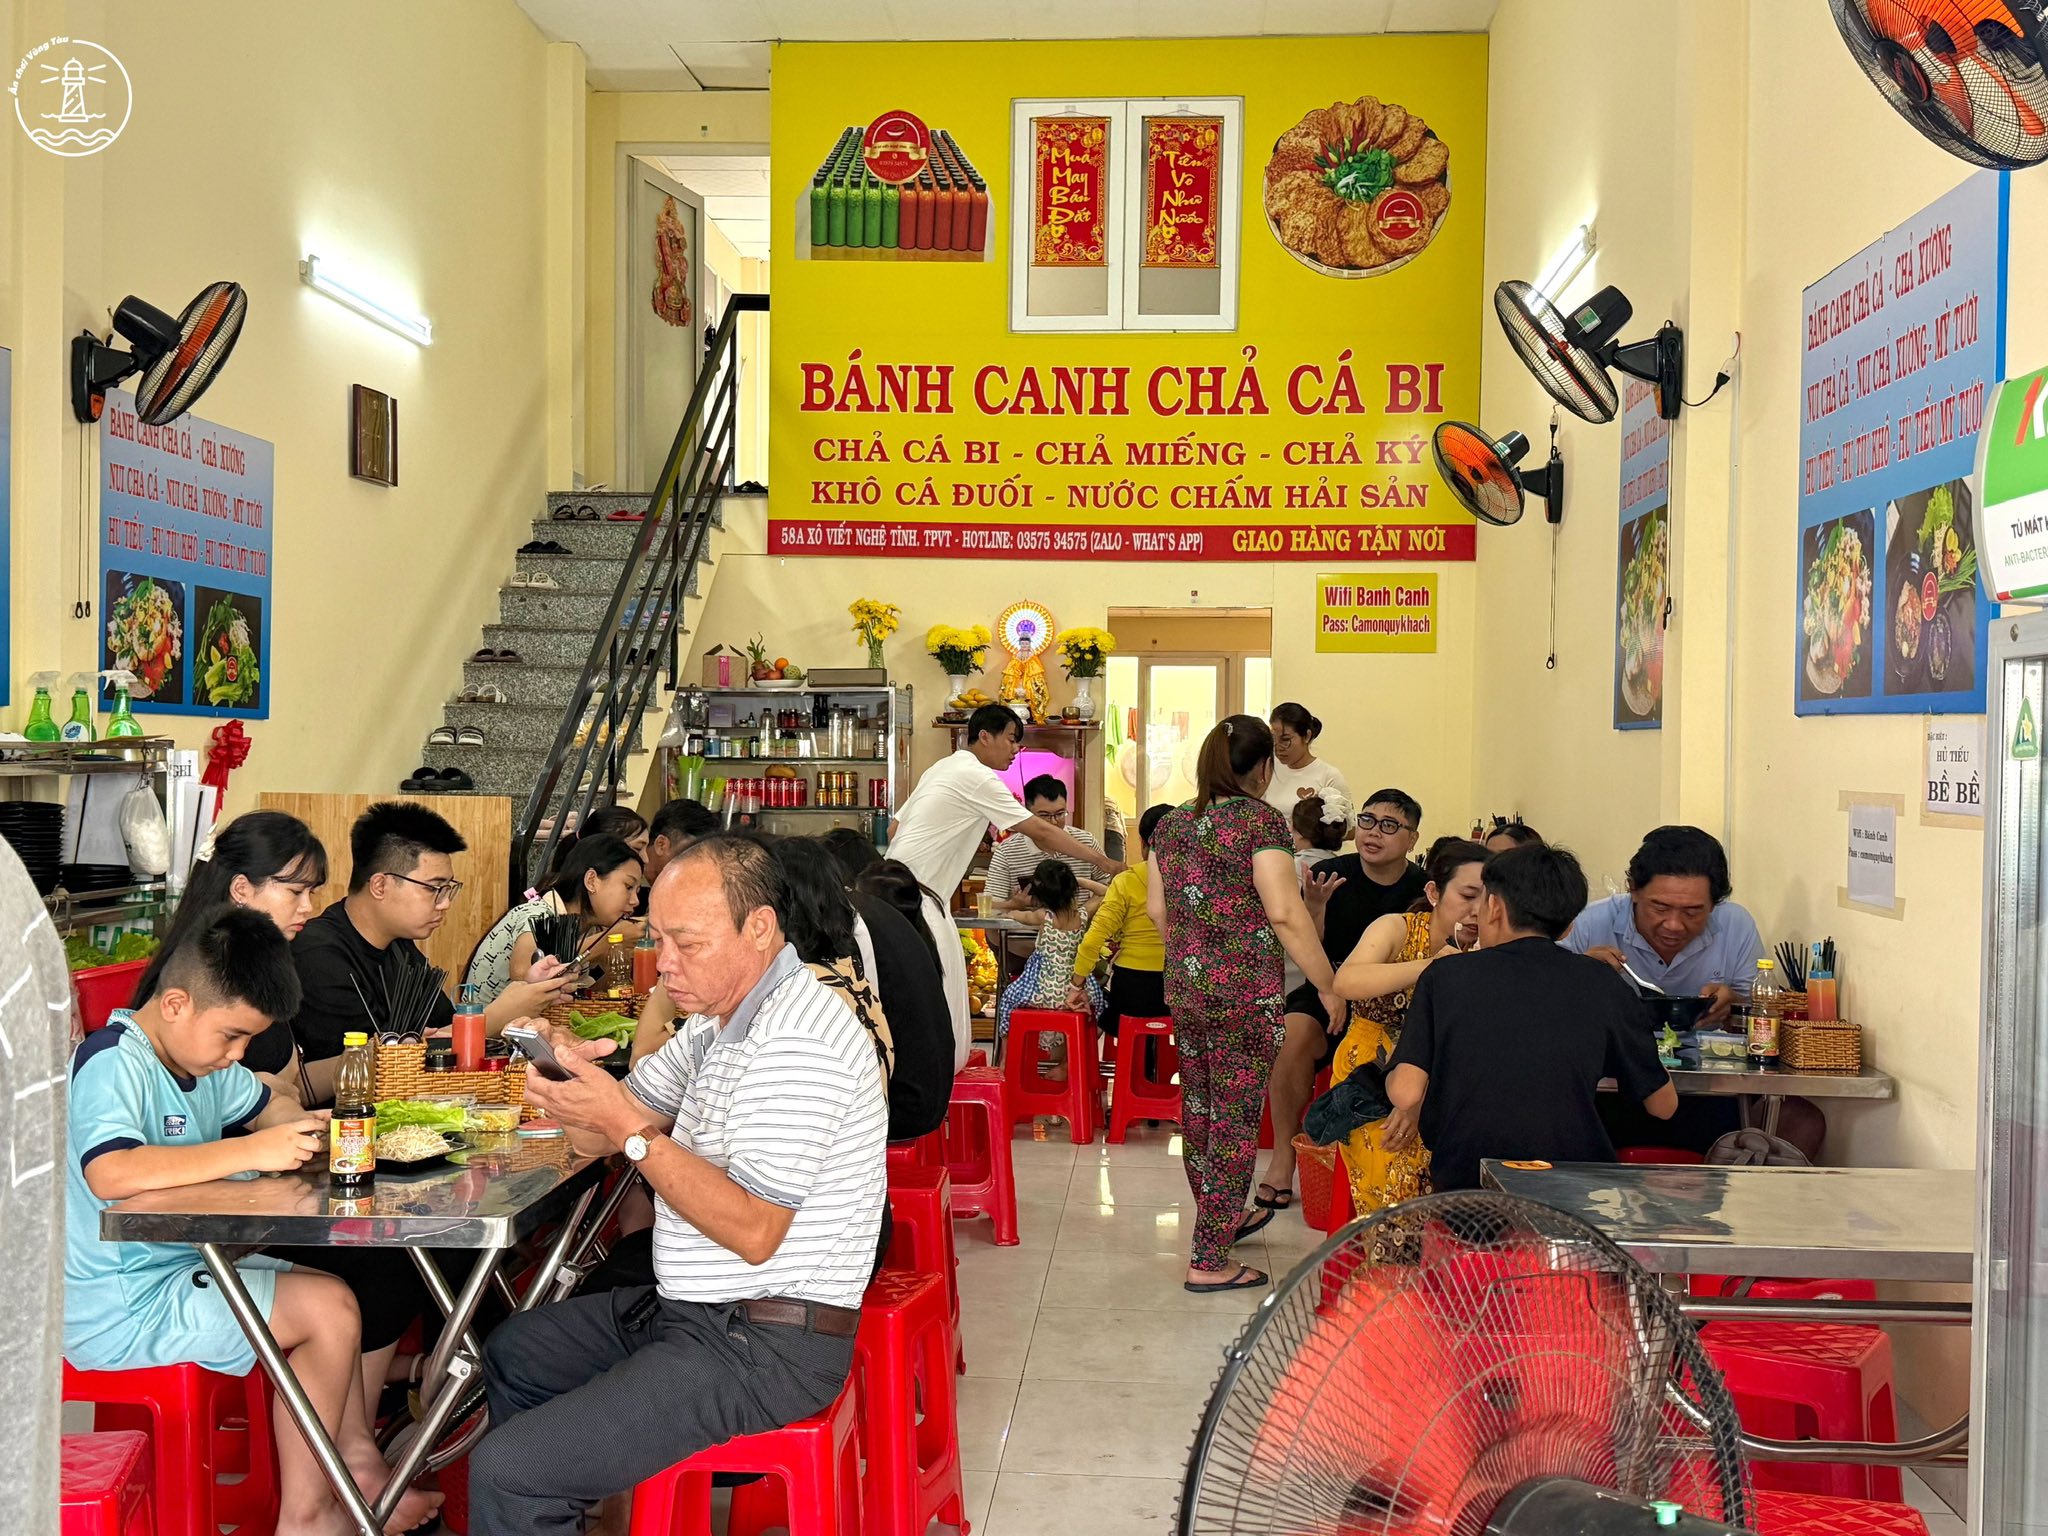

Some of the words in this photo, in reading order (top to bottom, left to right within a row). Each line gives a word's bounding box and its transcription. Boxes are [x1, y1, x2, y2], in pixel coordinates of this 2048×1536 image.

[1052, 167, 1088, 196] May
[1171, 169, 1196, 187] Vô
[1048, 186, 1091, 205] Bán
[1162, 189, 1203, 208] Như
[1159, 208, 1204, 227] Nước
[1808, 300, 1828, 351] BÁNH
[1830, 289, 1851, 338] CANH
[1853, 261, 1870, 324] CHẢ
[1873, 256, 1884, 311] CÁ
[1895, 232, 1914, 300] CHẢ
[1807, 381, 1819, 424] NUI
[1821, 358, 1836, 417] CHẢ
[1838, 354, 1850, 408] CÁ
[1856, 354, 1871, 400] NUI
[1873, 327, 1891, 390] CHẢ
[1934, 299, 1951, 362] MỲ
[800, 348, 955, 414] BÁNH
[973, 364, 1131, 416] CANH
[1148, 345, 1270, 416] CHẢ
[1287, 348, 1366, 415] CÁ
[1385, 363, 1445, 414] BI
[110, 401, 135, 441] BÁNH
[136, 418, 160, 449] CANH
[202, 432, 217, 467] CHẢ
[1915, 384, 1937, 454] TIẾU
[1939, 383, 1956, 444] MỲ
[813, 430, 890, 463] CHẢ
[902, 433, 951, 464] CÁ
[963, 440, 1000, 464] BI
[1035, 433, 1113, 465] CHẢ
[1125, 431, 1247, 465] MIẾNG
[1282, 432, 1363, 465] CHẢ
[1375, 434, 1428, 465] KÝ
[109, 462, 125, 492] NUI
[127, 460, 145, 497] CHẢ
[147, 467, 159, 501] CÁ
[166, 478, 180, 507] NUI
[182, 476, 198, 512] CHẢ
[811, 475, 882, 505] KHÔ
[895, 476, 940, 506] CÁ
[951, 473, 1034, 508] ĐUỐI
[1067, 479, 1159, 509] NƯỚC
[1170, 474, 1273, 509] CHẤM
[1284, 476, 1349, 509] HẢI
[1360, 476, 1429, 509] SẢN
[781, 526, 805, 545] 58A
[807, 524, 823, 545] XÔ
[826, 520, 852, 546] VIẾT
[855, 524, 886, 551] NGHỆ
[923, 529, 952, 547] TPVT
[962, 531, 1013, 549] HOTLINE:
[1016, 531, 1050, 550] 03575
[1053, 531, 1087, 550] 34575
[1091, 531, 1122, 553] (ZALO
[1132, 532, 1175, 550] WHAT'S
[1178, 532, 1203, 554] APP)
[1232, 530, 1283, 552] GIAO
[1290, 525, 1351, 552] HÀNG
[1358, 524, 1402, 556] TẬN
[1408, 526, 1446, 551] NƠI
[2011, 518, 2023, 539] TỦ
[2024, 514, 2043, 536] MÁT
[1324, 586, 1352, 606] Wifi
[1356, 586, 1391, 606] Banh
[1395, 586, 1430, 606] Canh
[1323, 614, 1348, 632] Pass:
[1351, 614, 1430, 635] Camonquykhach
[1928, 769, 1950, 802] BỀ
[1955, 770, 1980, 804] BỀ
